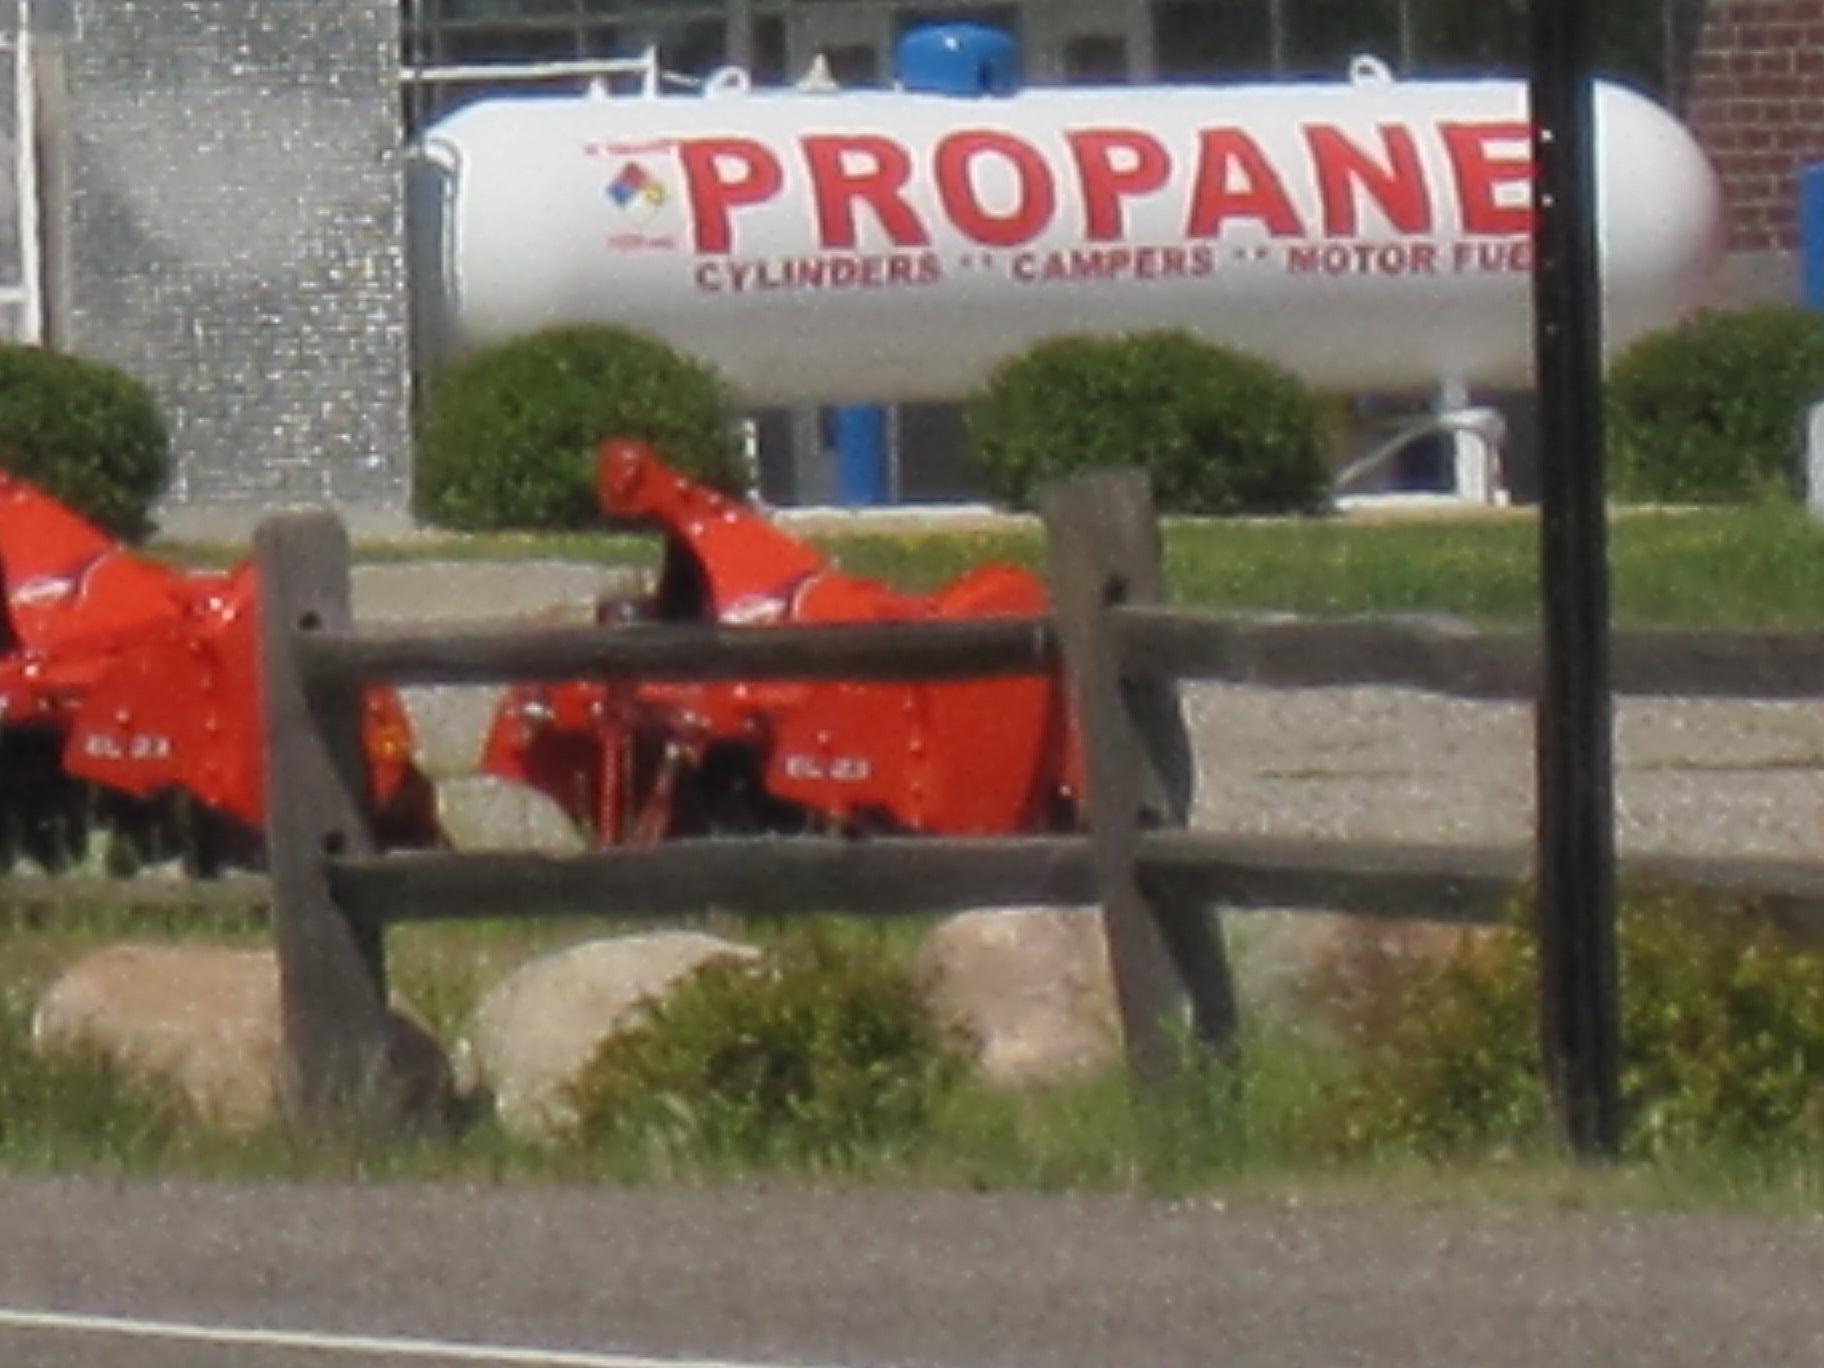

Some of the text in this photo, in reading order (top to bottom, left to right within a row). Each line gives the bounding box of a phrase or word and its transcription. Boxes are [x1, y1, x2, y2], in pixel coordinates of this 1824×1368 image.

[678, 124, 1533, 253] PROPANE
[695, 242, 1534, 292] CYLINDERS CAMPERS MOTOR FUE
